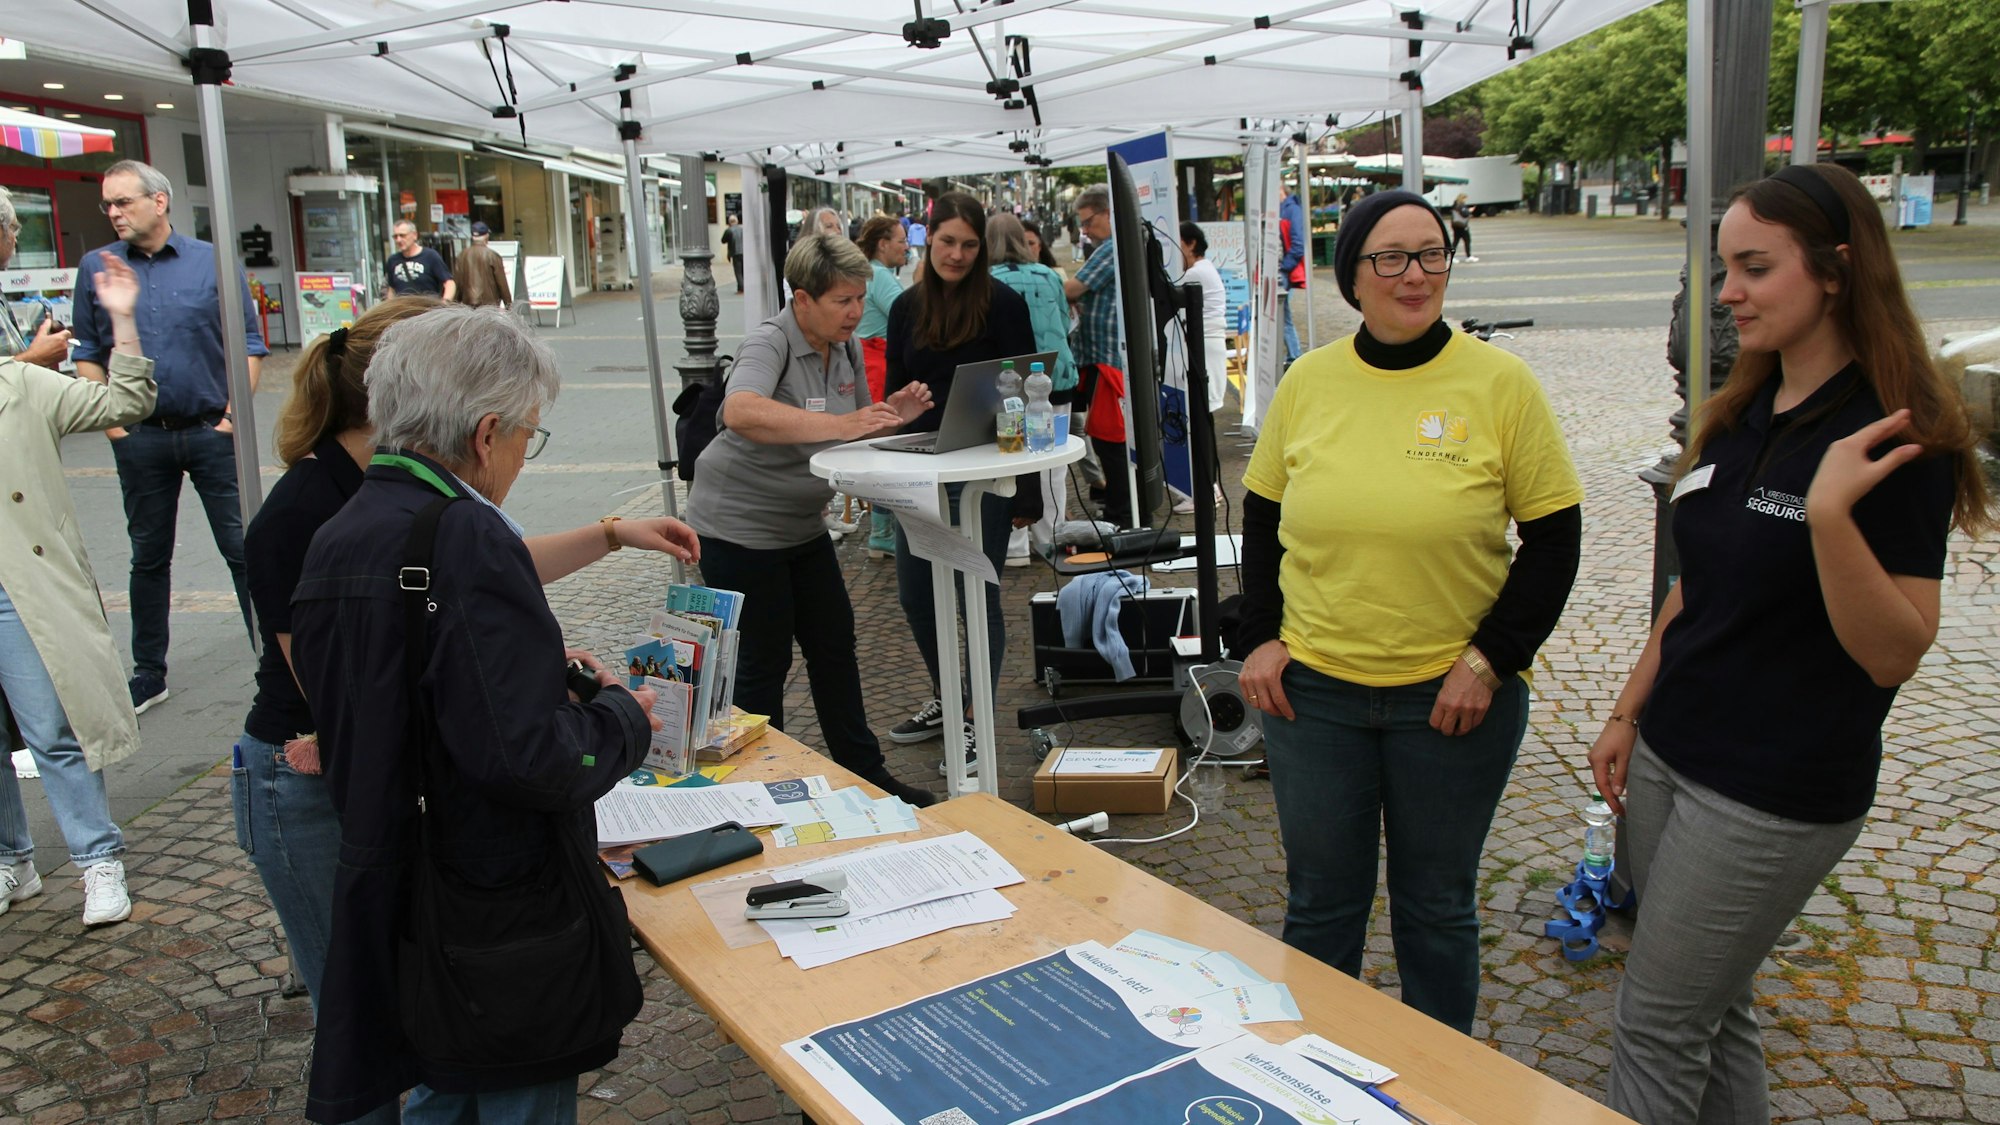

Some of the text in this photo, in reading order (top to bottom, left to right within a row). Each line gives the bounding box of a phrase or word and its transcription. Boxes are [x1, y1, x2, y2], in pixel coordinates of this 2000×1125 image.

[1406, 450, 1469, 463] KINDERHEIM
[1077, 950, 1118, 976] Inklusion
[1122, 976, 1155, 996] Jetzt!
[1244, 1053, 1332, 1105] Verfahrenslotse
[1250, 1070, 1267, 1084] AUS
[1264, 1079, 1292, 1098] EINER
[1289, 1094, 1317, 1114] HAND
[1215, 1101, 1245, 1122] Inklusive
